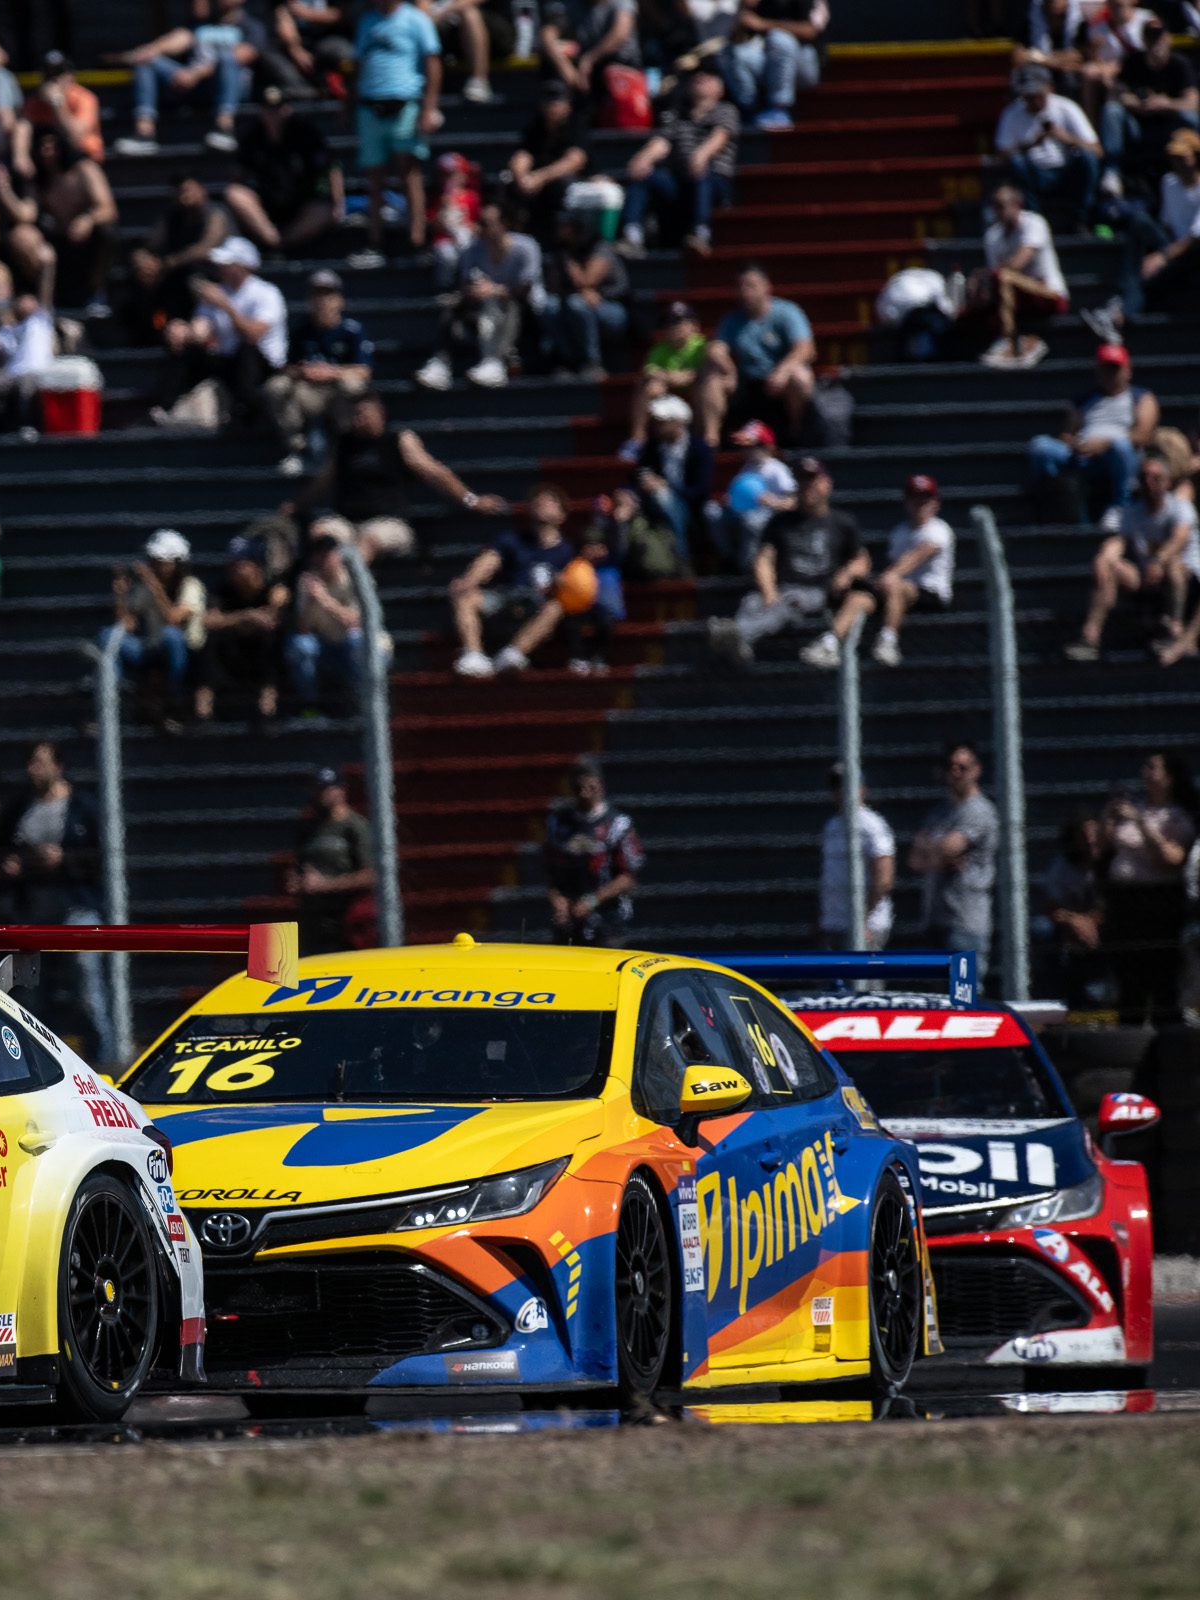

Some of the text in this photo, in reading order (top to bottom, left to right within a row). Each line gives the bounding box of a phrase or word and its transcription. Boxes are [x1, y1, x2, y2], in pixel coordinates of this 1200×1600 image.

[354, 988, 557, 1007] Ipiranga
[813, 1015, 1003, 1041] ALE
[175, 1037, 302, 1054] T.CAMILO
[747, 1024, 776, 1067] 16
[72, 1074, 100, 1095] Shell
[166, 1051, 283, 1094] 16
[83, 1093, 141, 1129] HELIX
[920, 1176, 995, 1199] Mobil
